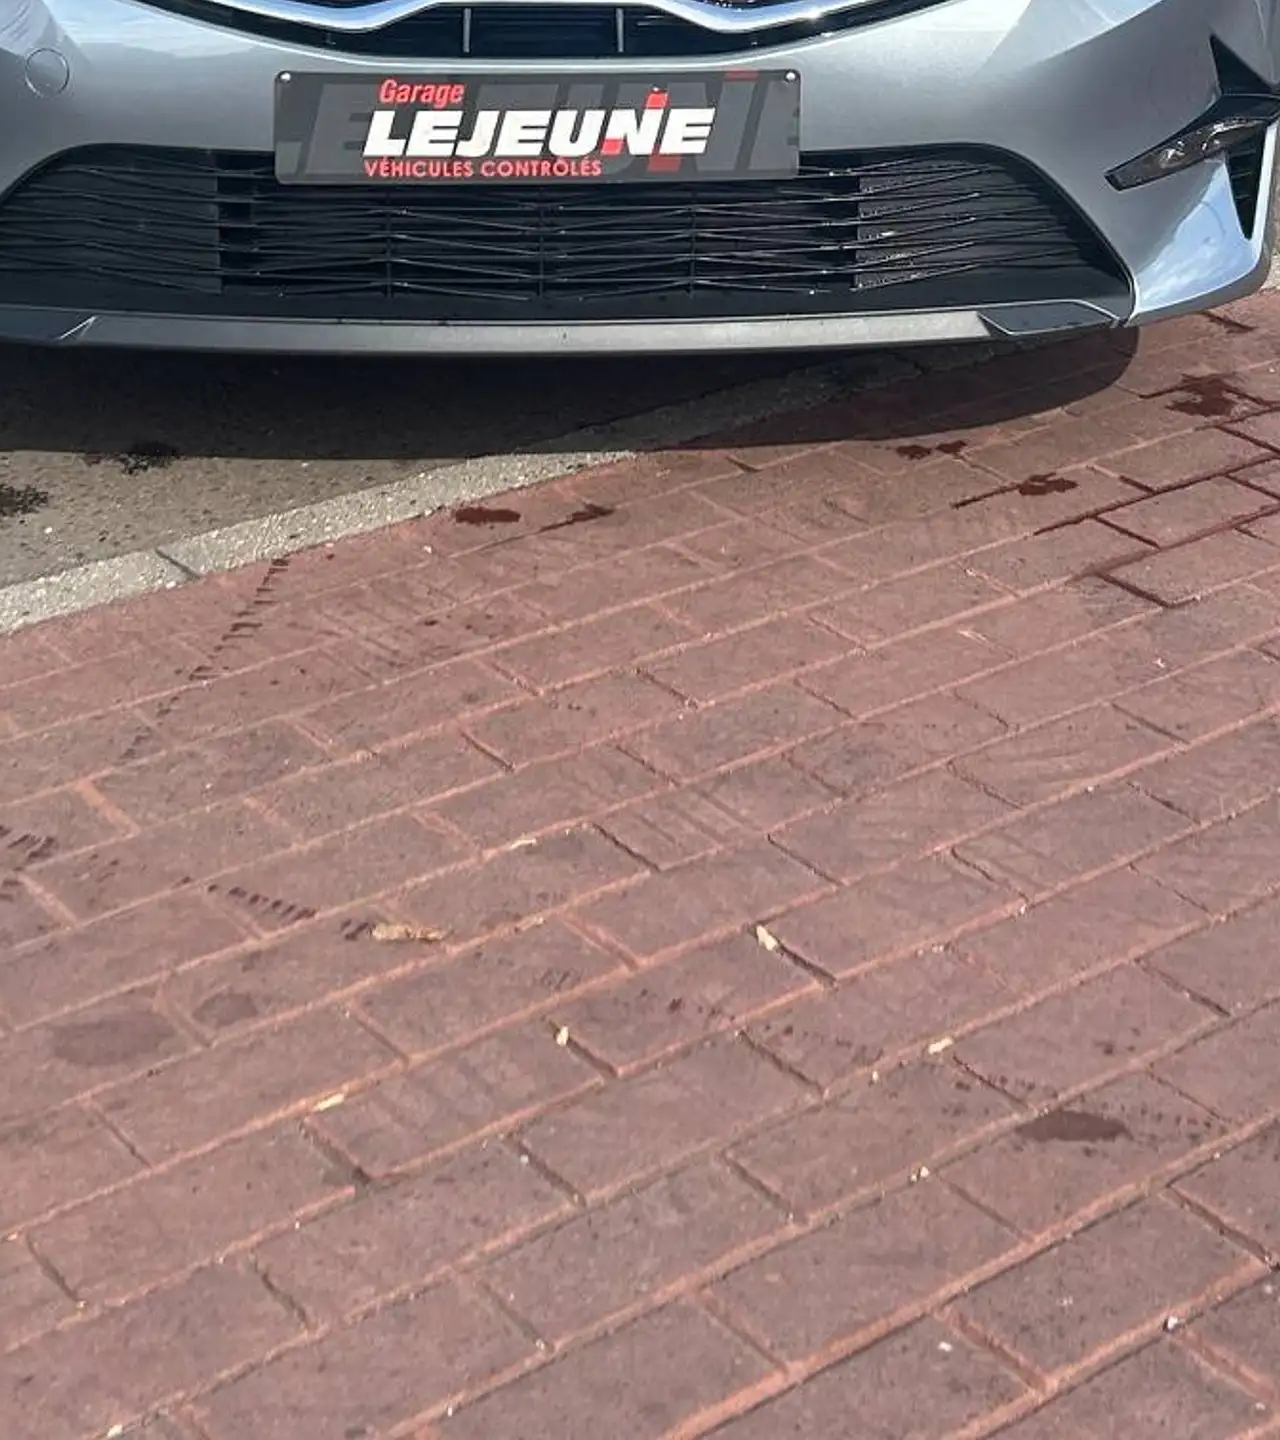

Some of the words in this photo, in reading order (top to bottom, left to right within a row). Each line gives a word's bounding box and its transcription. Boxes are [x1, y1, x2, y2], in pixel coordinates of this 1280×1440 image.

[379, 78, 466, 108] Garage
[363, 107, 716, 158] LEJEUNE
[365, 156, 475, 177] VÉHICULES
[480, 156, 603, 177] CONTRÔLÉS
